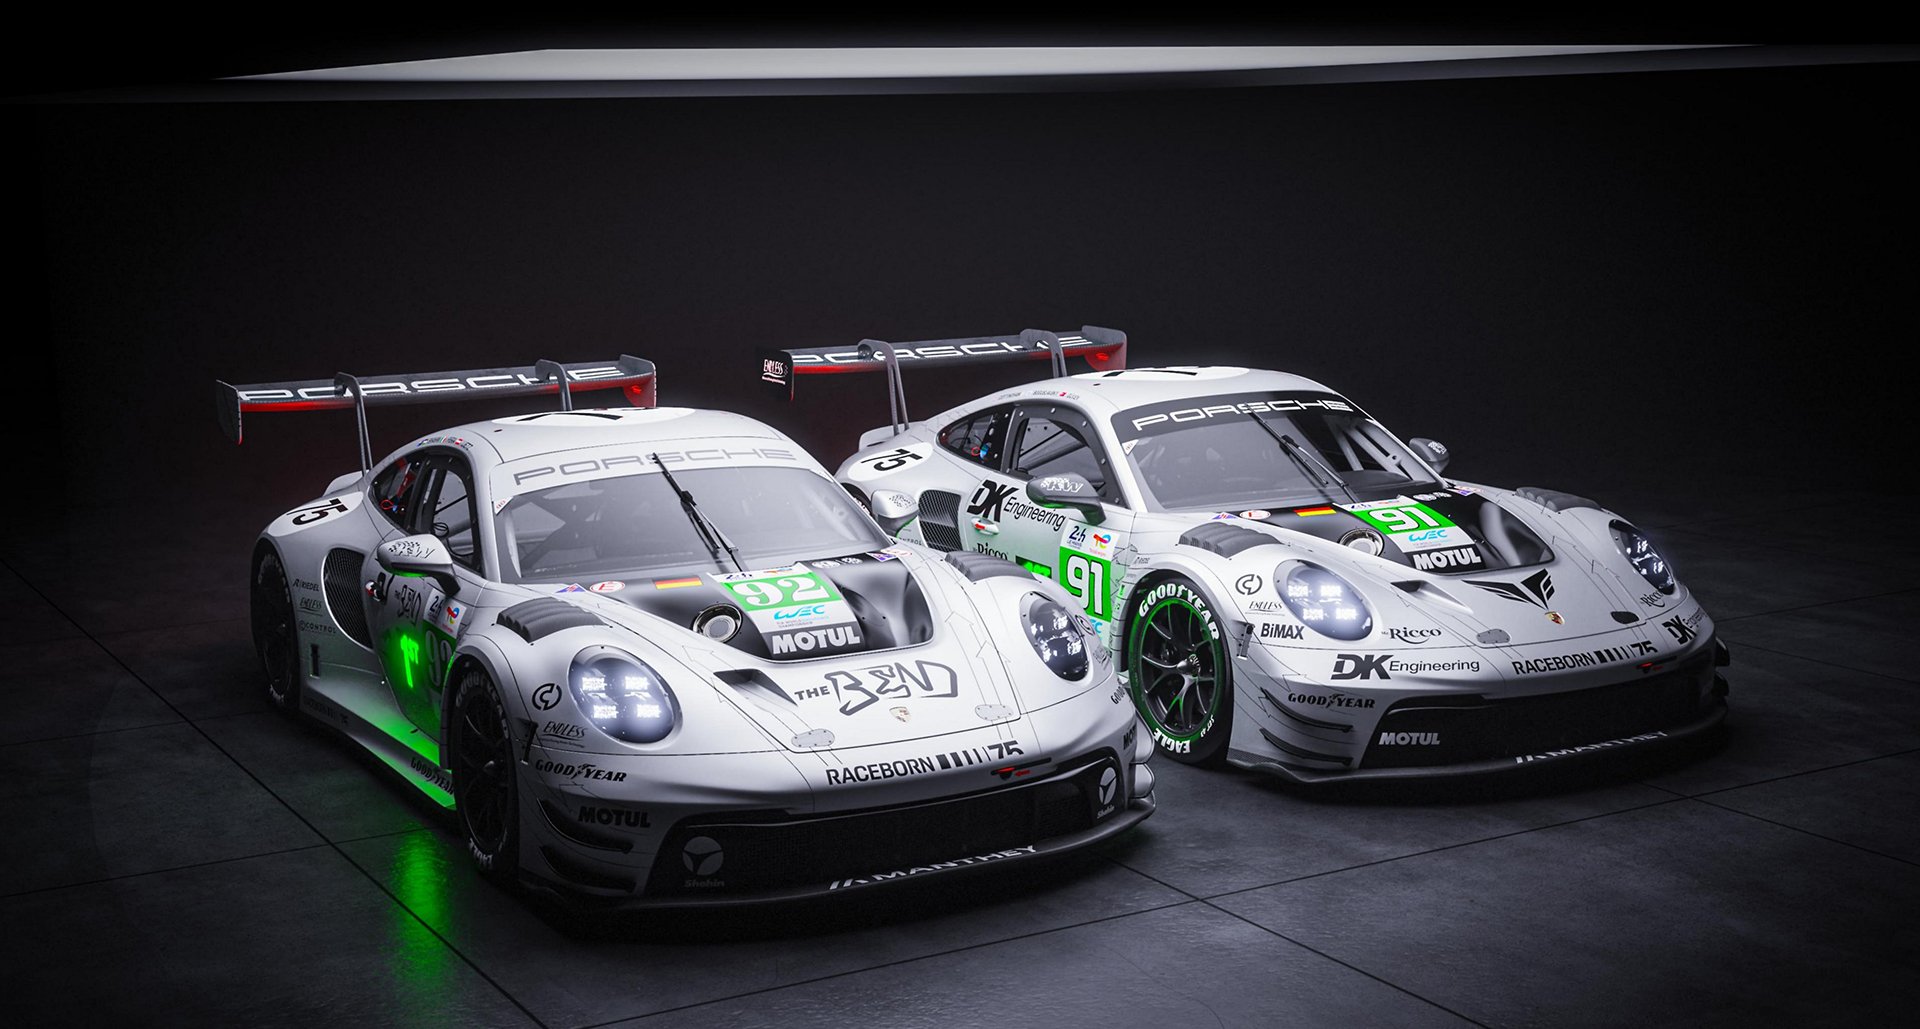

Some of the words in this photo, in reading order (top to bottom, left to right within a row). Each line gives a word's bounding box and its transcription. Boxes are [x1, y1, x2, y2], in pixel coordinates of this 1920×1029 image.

[1132, 399, 1354, 431] PORSCHE
[513, 446, 796, 486] PORSCHE
[862, 447, 923, 472] 75
[286, 497, 349, 526] 75
[966, 479, 1019, 523] DK
[1003, 496, 1067, 532] Engineering
[1367, 505, 1441, 533] 91
[1408, 529, 1448, 542] WEC
[1412, 547, 1482, 570] MOTUL
[733, 576, 831, 607] 92
[1067, 554, 1104, 617] 91
[774, 604, 826, 621] WEC
[772, 626, 861, 655] MOTUL
[1260, 622, 1305, 640] BiMAX
[1389, 626, 1442, 644] Ricco
[1331, 653, 1395, 681] DK
[1389, 660, 1481, 675] Engineering
[1511, 652, 1597, 675] RACEBORN
[1630, 640, 1659, 657] 75
[794, 685, 831, 701] THE
[543, 720, 589, 739] ENDLESS
[1153, 727, 1191, 754] EAGLE
[1378, 732, 1441, 746] MOTUL
[825, 756, 936, 786] RACEBORN
[987, 740, 1025, 760] 75
[578, 805, 651, 829] MOTUL
[871, 844, 1037, 882] MANTHEY
